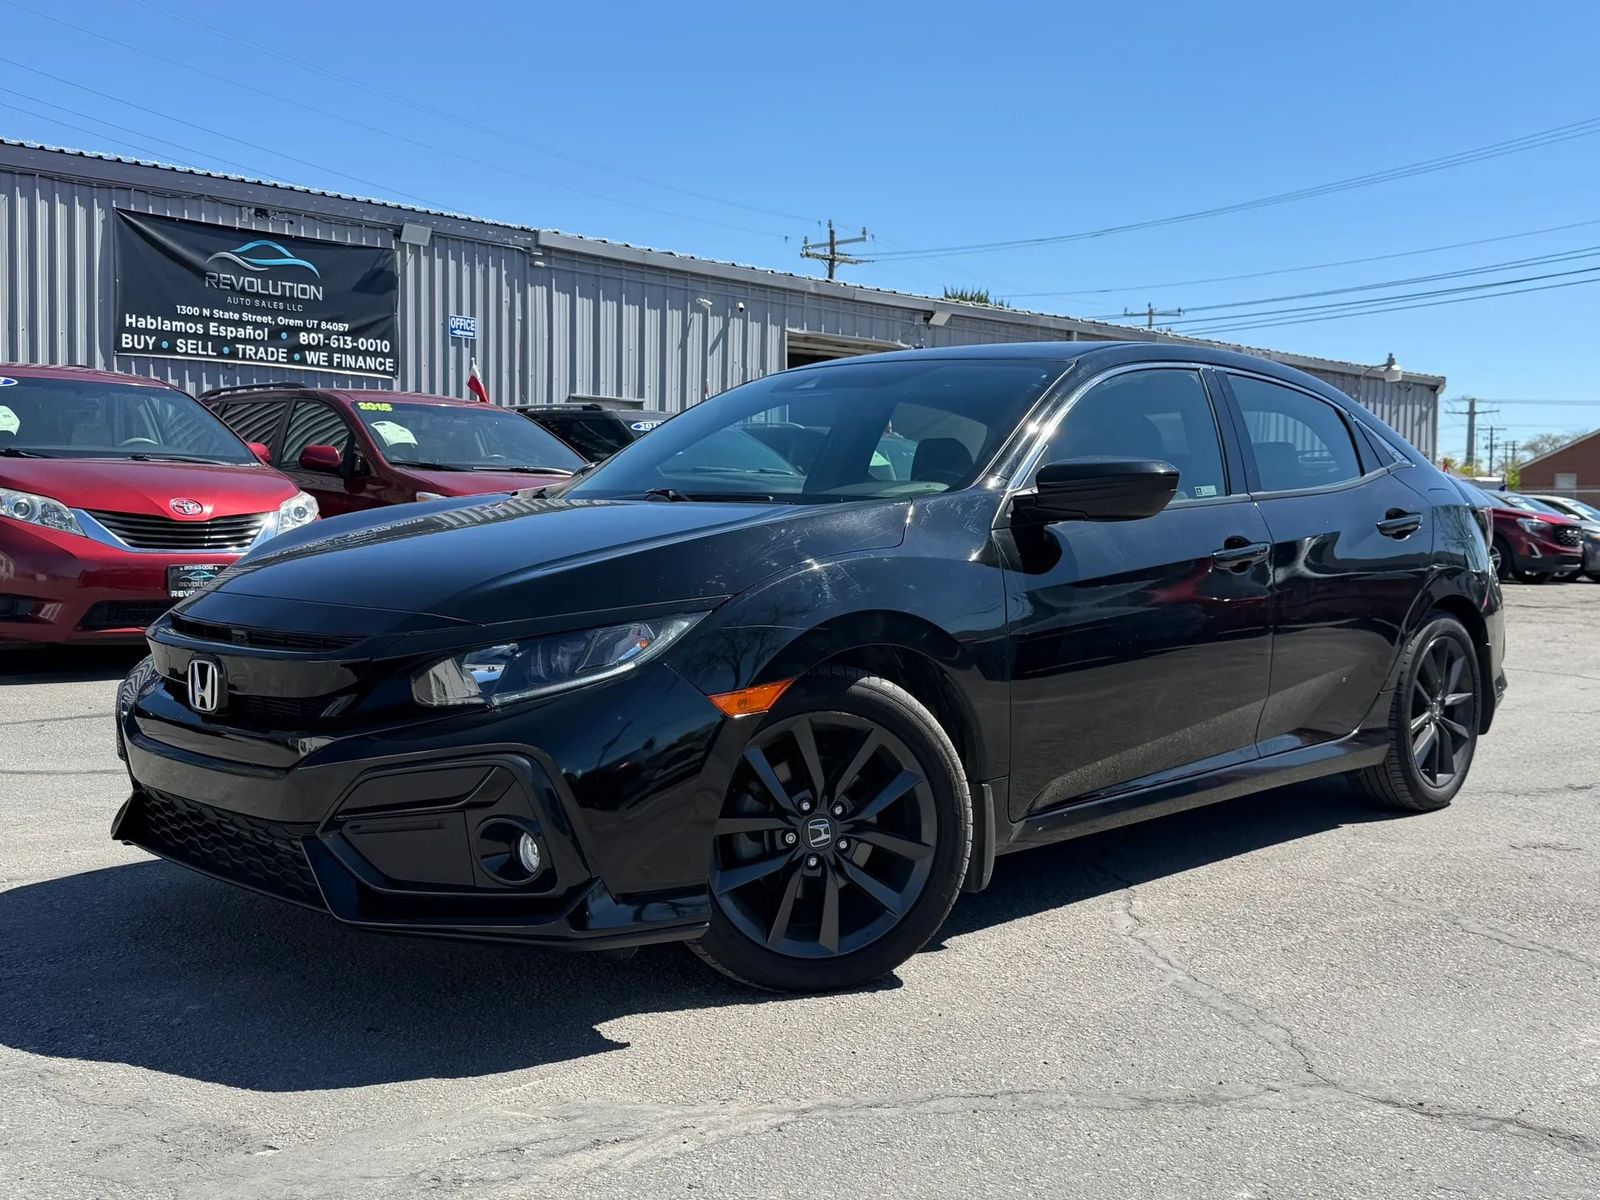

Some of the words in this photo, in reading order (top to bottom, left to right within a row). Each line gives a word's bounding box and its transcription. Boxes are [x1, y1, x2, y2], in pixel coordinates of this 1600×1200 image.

[204, 271, 323, 301] REVOLUTION
[176, 304, 200, 316] 1300
[202, 307, 210, 318] N
[212, 308, 240, 321] State
[242, 312, 275, 326] Street,
[277, 316, 304, 328] Orem
[306, 319, 319, 329] UT
[320, 321, 349, 332] 84057
[226, 296, 251, 306] AUTO
[254, 299, 284, 310] SALES
[286, 303, 304, 312] LLC
[125, 313, 204, 335] Hablamos
[209, 322, 269, 341] Español
[298, 331, 391, 353] 801-613-0010
[450, 317, 475, 331] OFFICE
[121, 333, 157, 351] BUY
[176, 338, 217, 356] SELL
[235, 343, 288, 363] TRADE
[305, 350, 329, 366] WE
[333, 352, 394, 372] FINANCE
